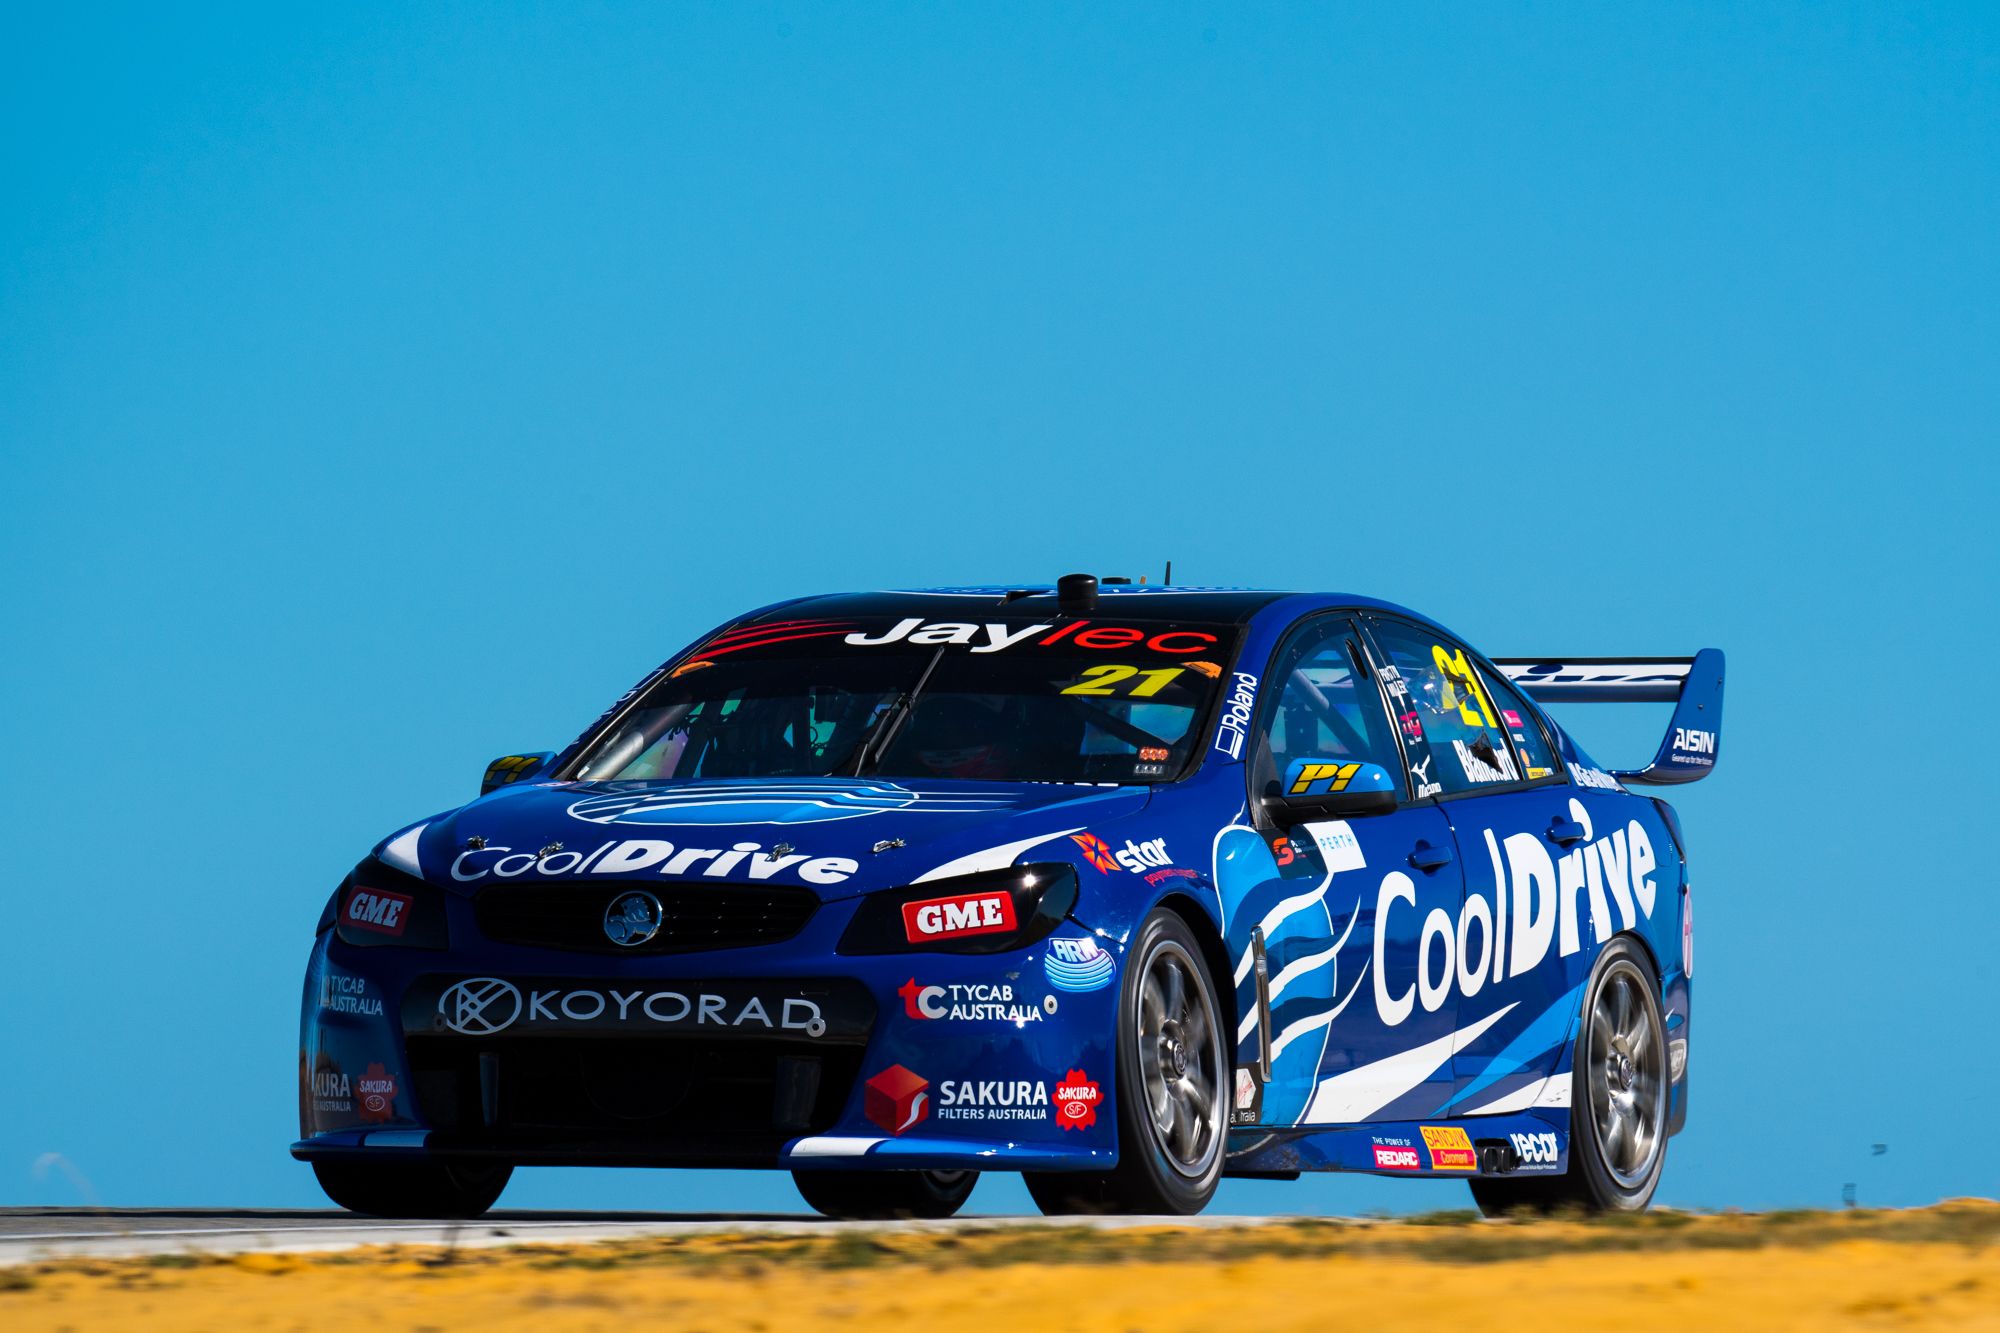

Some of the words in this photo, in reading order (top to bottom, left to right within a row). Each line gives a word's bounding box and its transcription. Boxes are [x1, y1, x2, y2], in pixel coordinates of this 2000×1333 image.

[845, 618, 1217, 653] Jaylec
[1060, 664, 1185, 697] 21
[1222, 672, 1257, 734] Roland
[1673, 728, 1715, 754] AISIN
[1319, 833, 1355, 851] PERTH
[450, 840, 859, 884] CoolDrive
[1115, 837, 1174, 874] star
[349, 892, 404, 928] GME
[917, 898, 1003, 934] GME
[1374, 798, 1657, 1026] CoolDrive
[331, 975, 364, 994] TYCAB
[948, 984, 1013, 1001] TYCAB
[328, 996, 383, 1016] AUSTRALIA
[530, 990, 821, 1029] KOYORAD
[948, 1004, 1043, 1022] AUSTRALIA
[359, 1080, 393, 1093] SAKURA
[939, 1081, 1048, 1106] SAKURA
[1057, 1086, 1097, 1101] SAKURA
[938, 1108, 985, 1120] FILTERS
[987, 1109, 1047, 1120] AUSTRALIA
[1422, 1128, 1471, 1149] SANDVIK
[1376, 1149, 1418, 1166] REDARC
